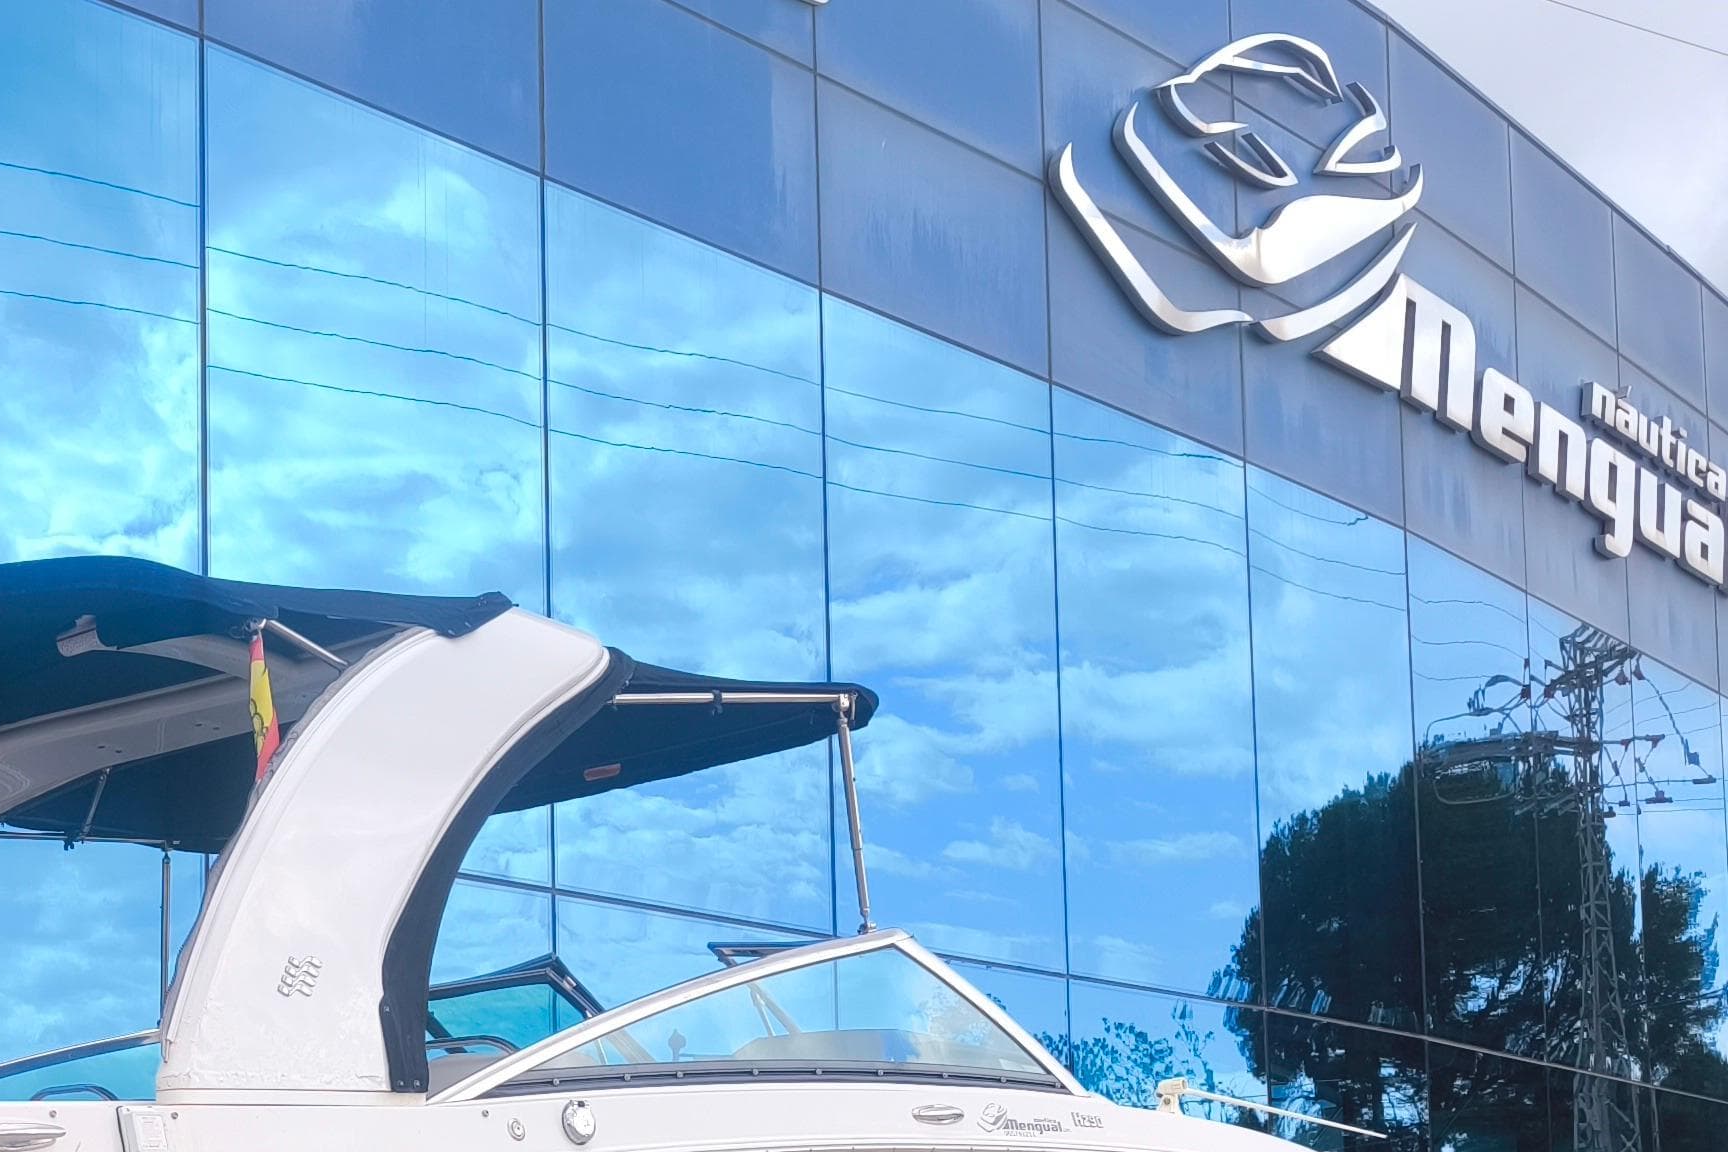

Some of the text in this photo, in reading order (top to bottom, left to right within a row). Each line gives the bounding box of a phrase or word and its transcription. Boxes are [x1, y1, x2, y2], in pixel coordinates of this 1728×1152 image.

[1311, 273, 1727, 586] Mengua
[1581, 380, 1727, 502] náutica
[1002, 1119, 1063, 1134] Mengual
